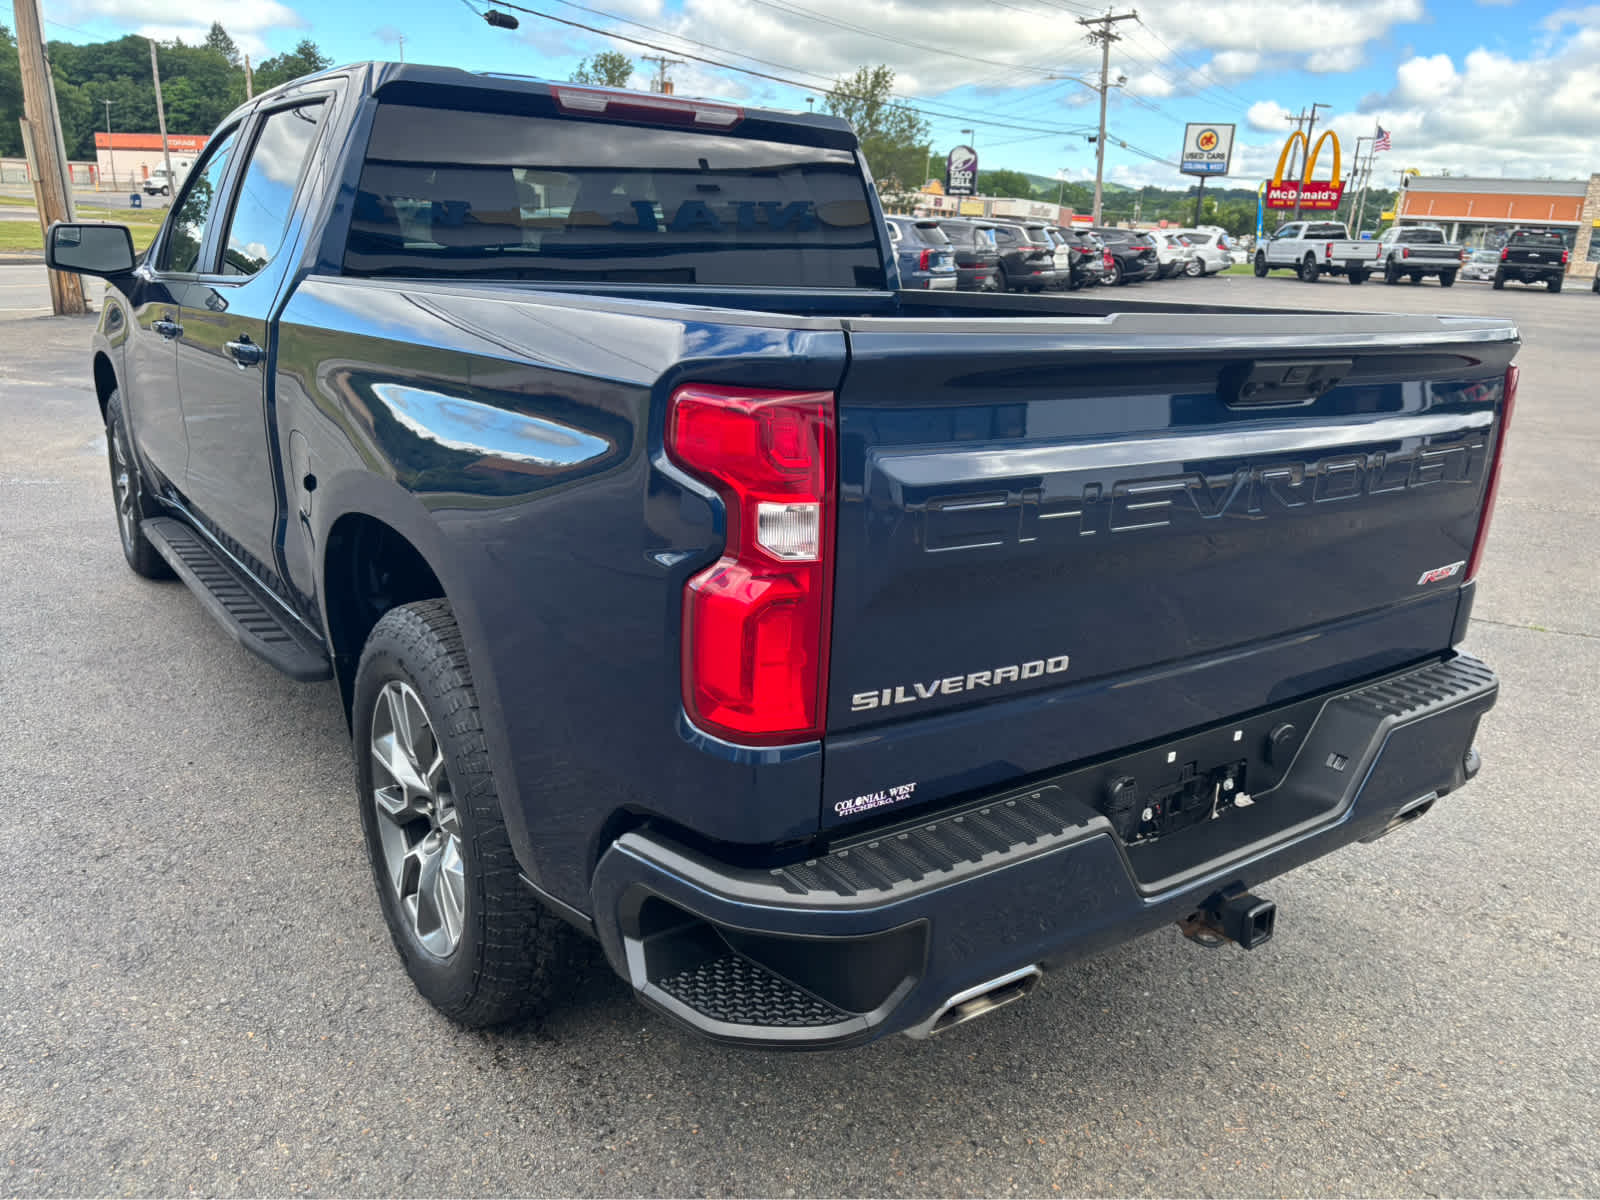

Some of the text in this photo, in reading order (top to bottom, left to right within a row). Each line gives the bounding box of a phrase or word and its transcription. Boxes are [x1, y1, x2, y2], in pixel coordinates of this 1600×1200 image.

[1185, 152, 1225, 160] USED CARS
[950, 171, 972, 179] TACO
[950, 179, 971, 187] BELL
[923, 441, 1485, 553] CHEVROLET
[1416, 560, 1466, 585] RST
[850, 654, 1070, 711] SILVERADO
[834, 782, 917, 812] COLONIAL WEST
[895, 793, 911, 801] MA
